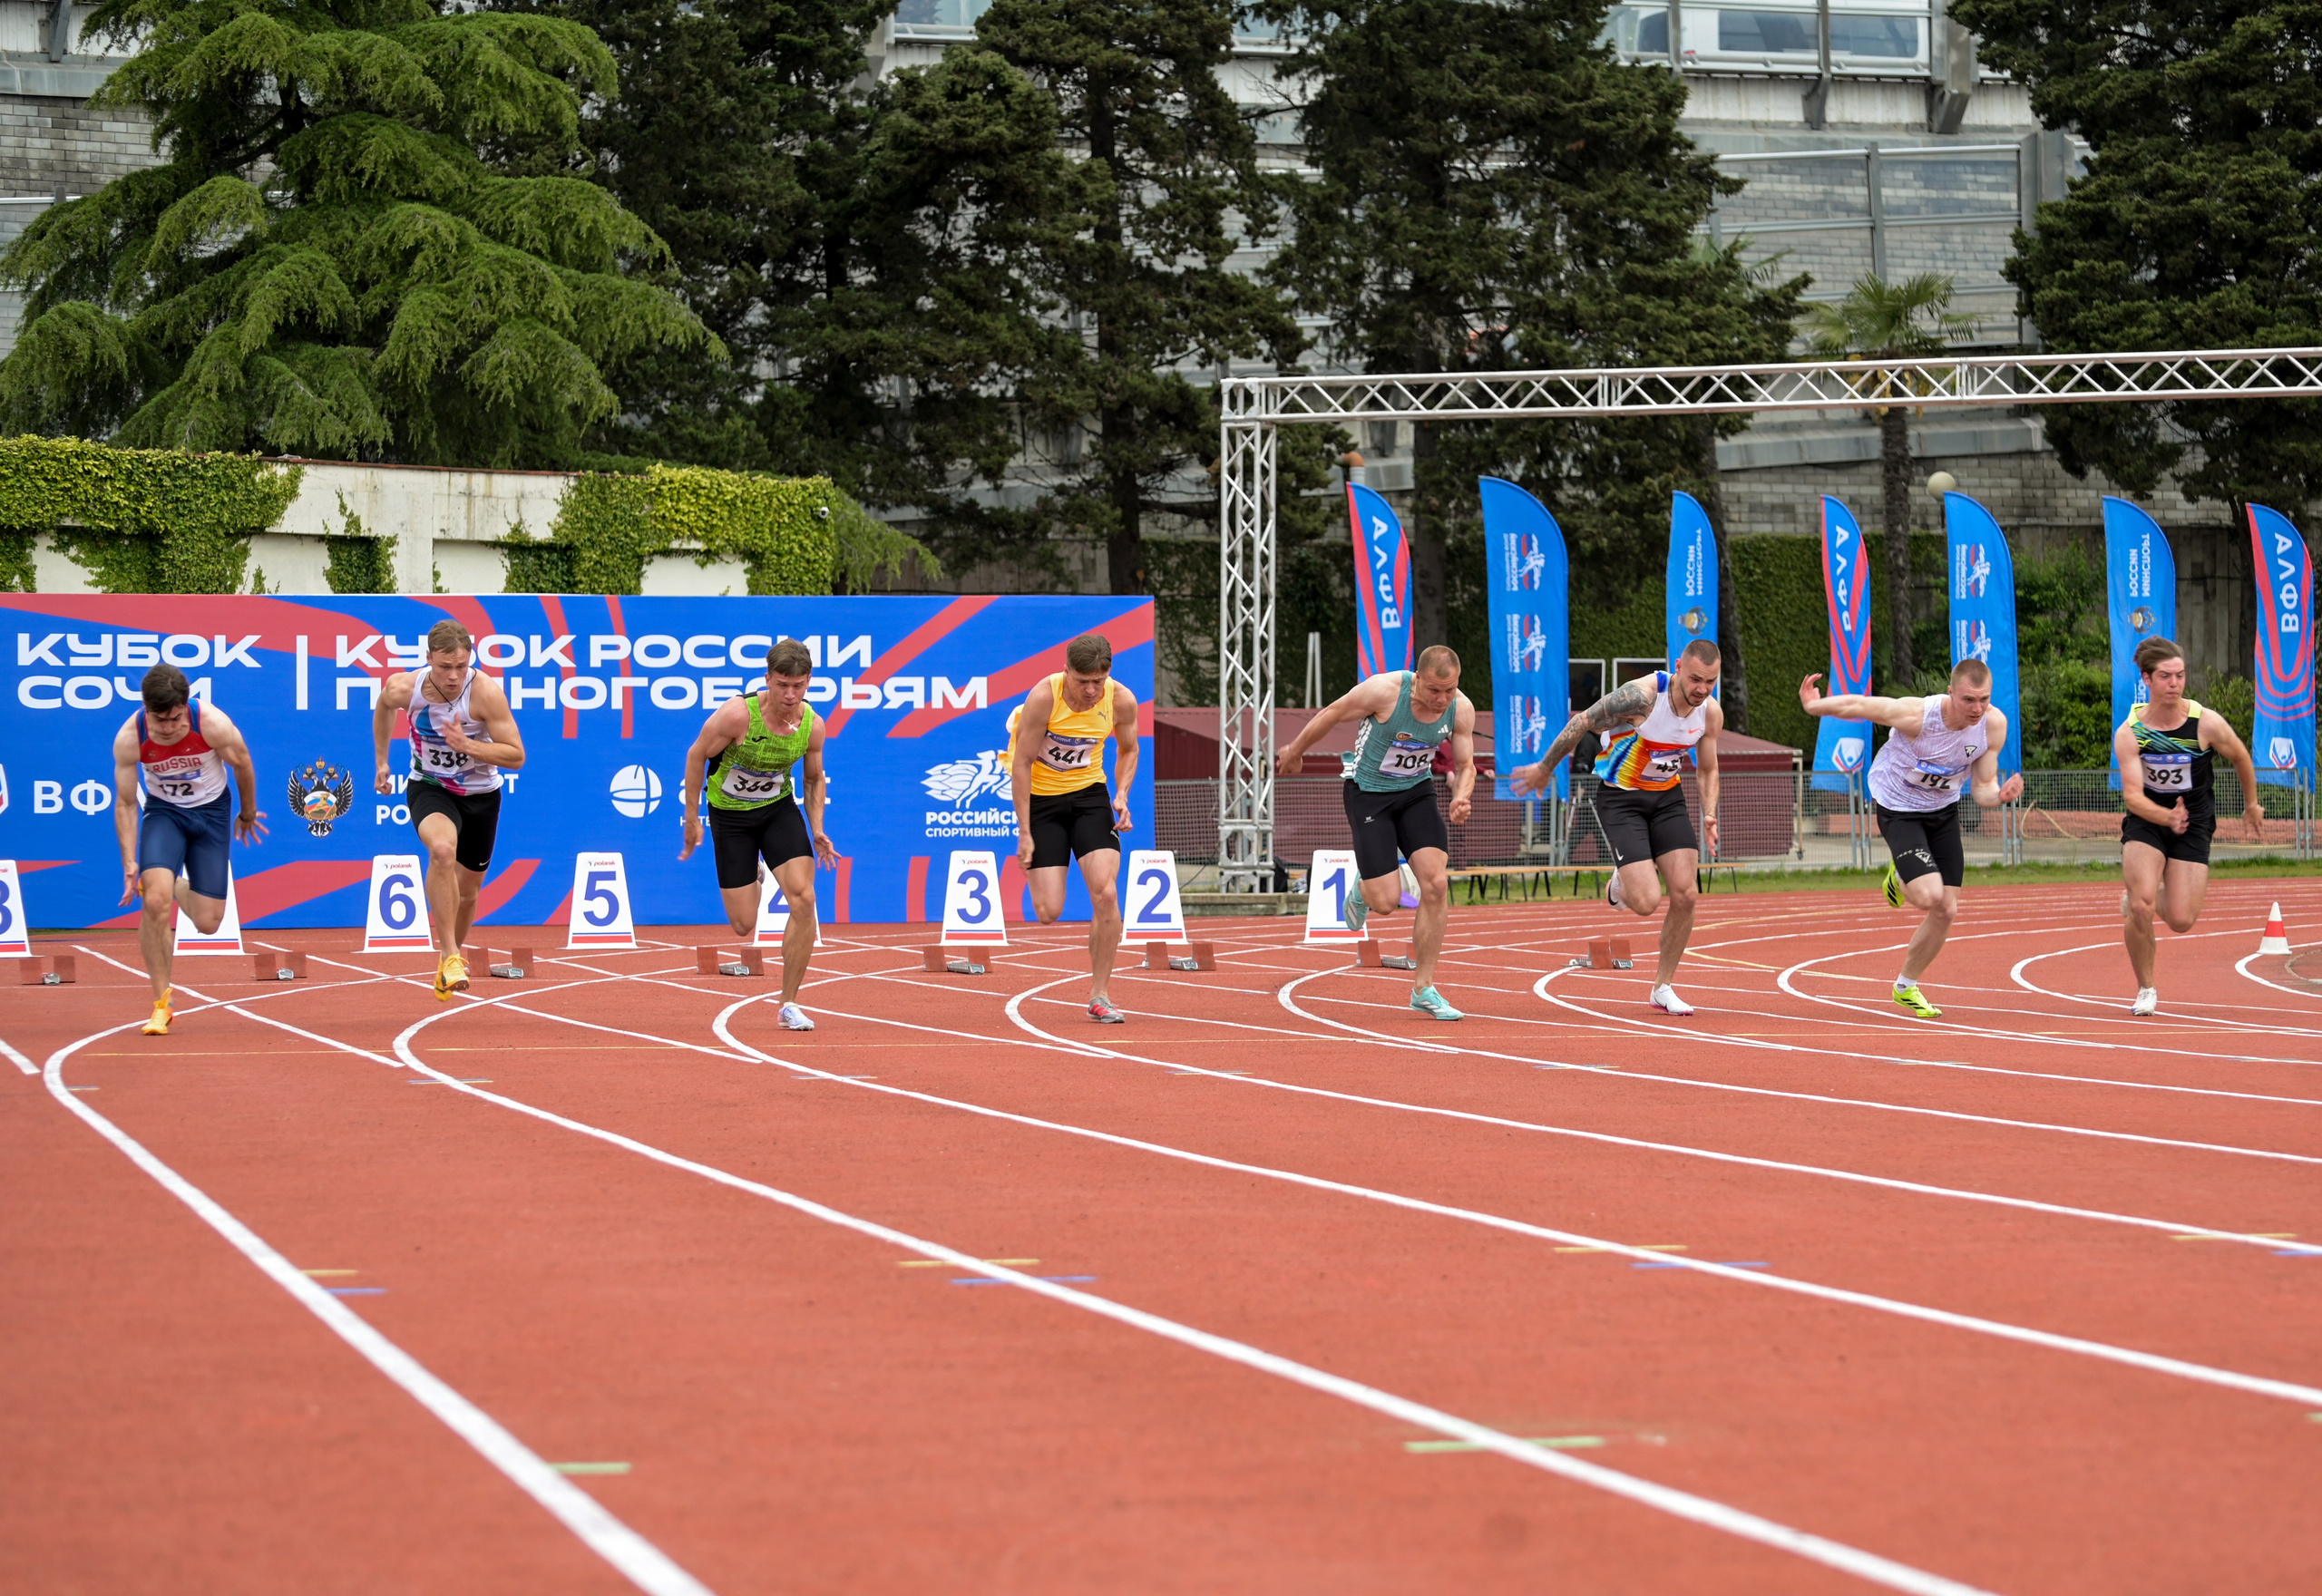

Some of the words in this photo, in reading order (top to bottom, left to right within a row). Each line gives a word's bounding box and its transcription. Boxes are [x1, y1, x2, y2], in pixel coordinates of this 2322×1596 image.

[17, 633, 262, 667] КУБОК
[337, 635, 577, 667] КУОК
[152, 757, 202, 773] RUSSIA
[429, 748, 468, 768] 338
[1048, 746, 1086, 764] 441
[2146, 766, 2183, 784] 393
[925, 825, 1010, 837] СПОРТИВНЫЙ
[379, 873, 416, 930] 6
[583, 871, 620, 927] 5
[956, 869, 991, 924] 3
[1137, 868, 1172, 923] 2
[1322, 868, 1346, 922] 1
